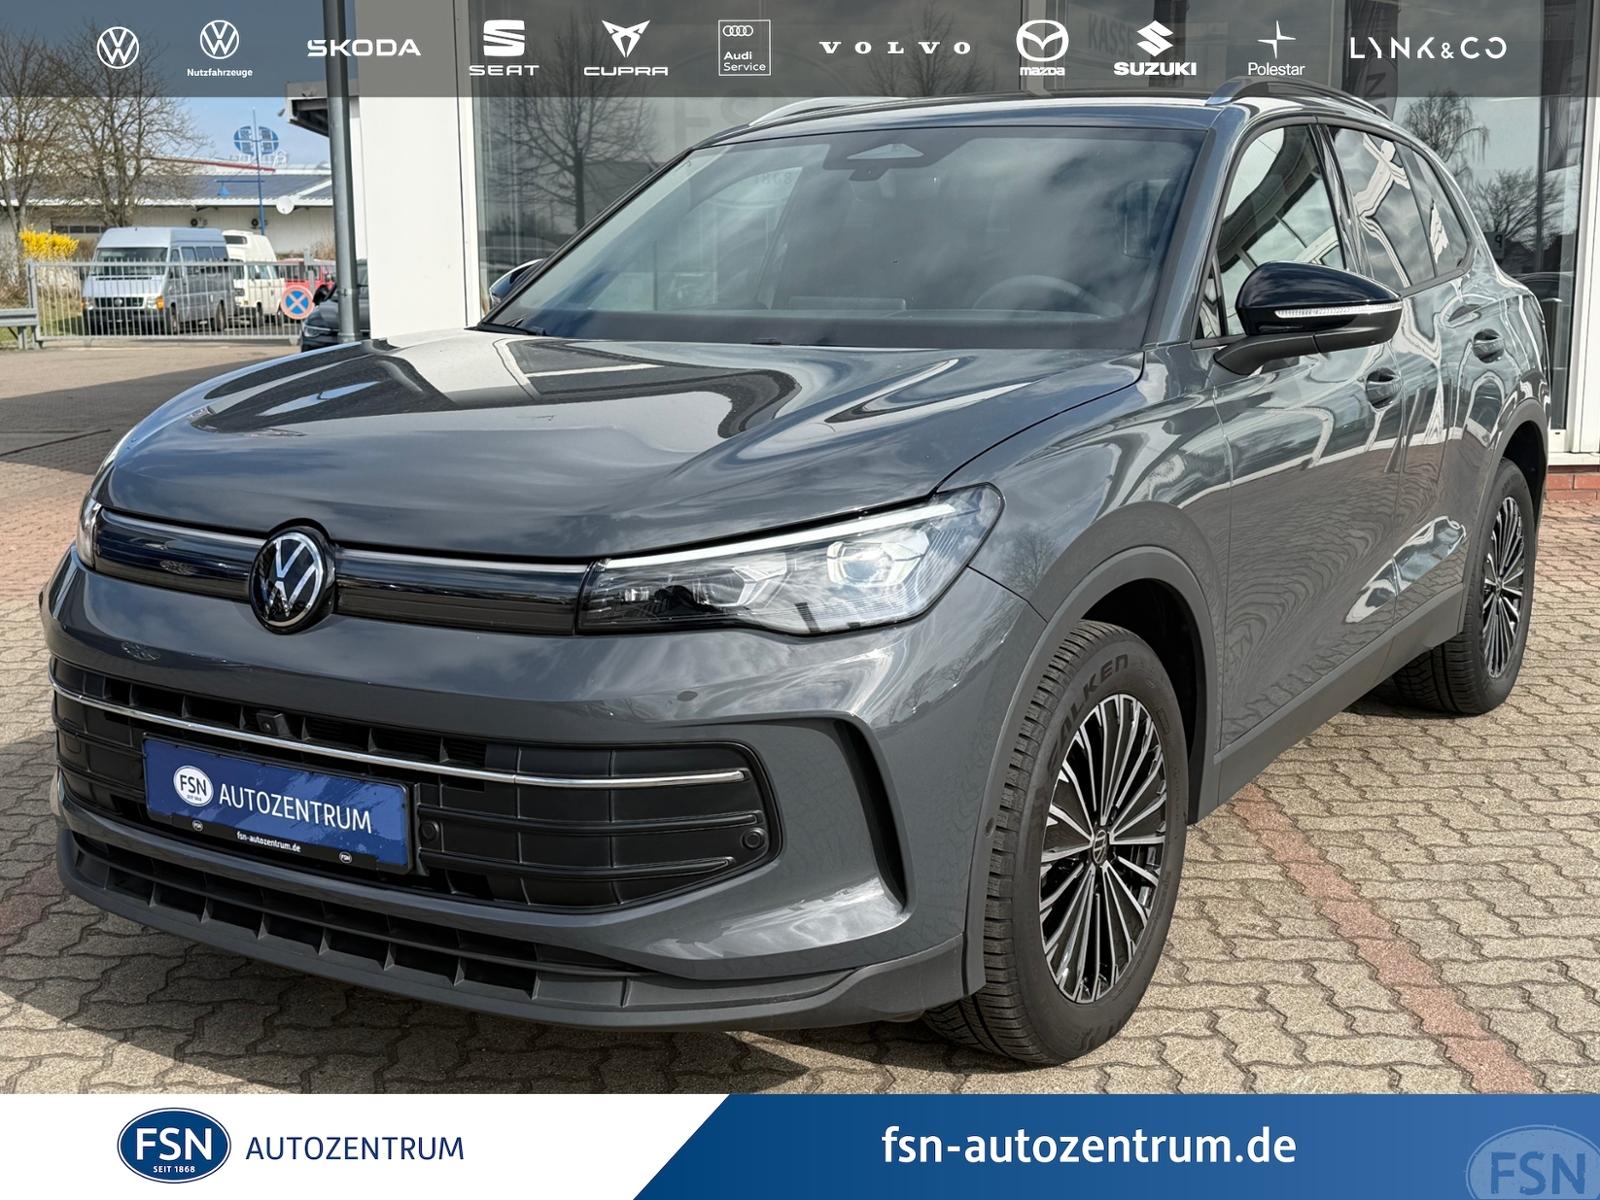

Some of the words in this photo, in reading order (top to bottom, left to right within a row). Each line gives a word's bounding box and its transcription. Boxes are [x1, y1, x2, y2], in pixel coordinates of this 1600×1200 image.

[179, 774, 207, 797] FSN
[218, 783, 372, 834] AUTOZENTRUM
[236, 830, 301, 853] fsn-autozentrum.de
